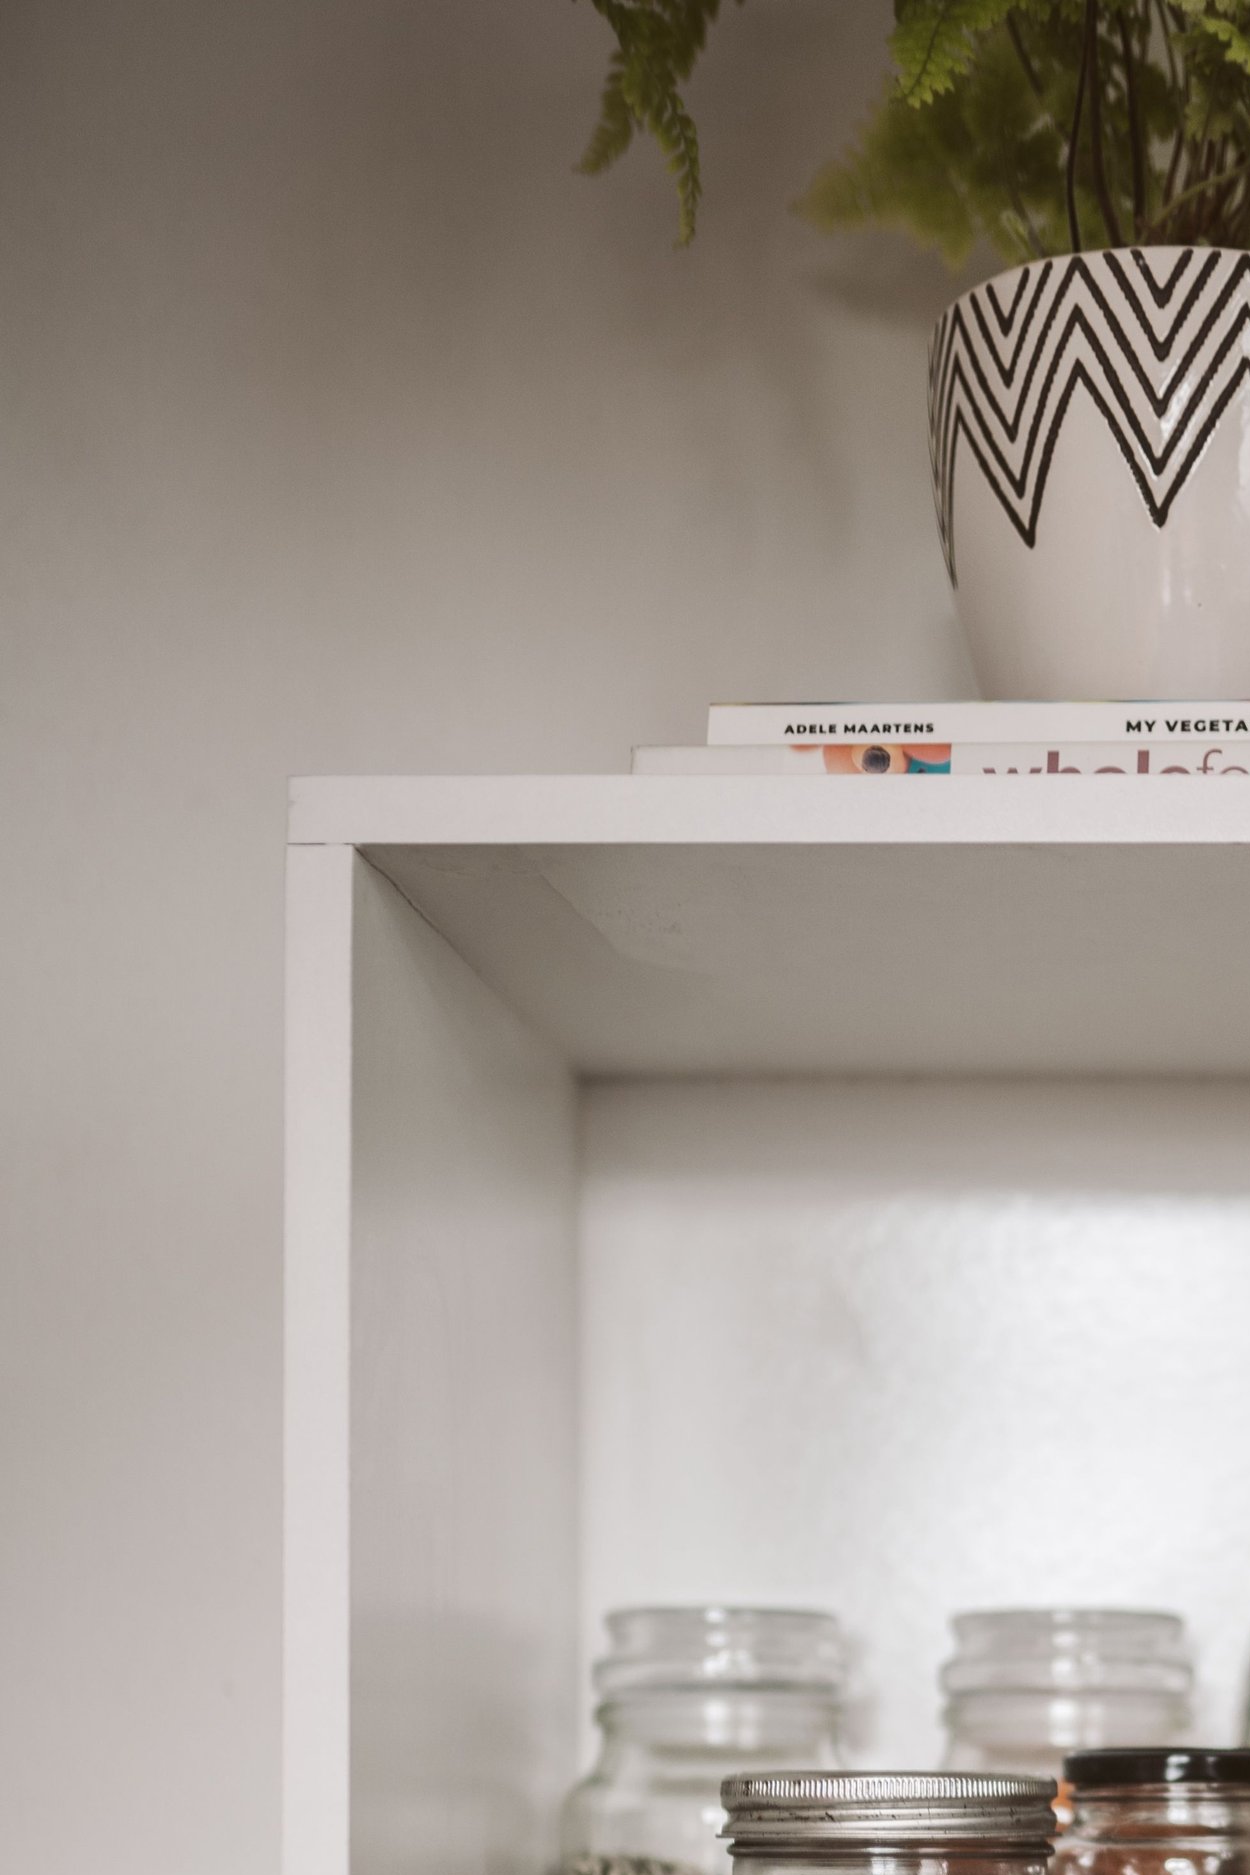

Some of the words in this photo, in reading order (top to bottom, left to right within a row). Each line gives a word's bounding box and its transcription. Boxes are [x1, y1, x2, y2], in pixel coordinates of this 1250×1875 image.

[784, 723, 837, 735] ADELE
[843, 722, 934, 734] MAARTENS
[1125, 720, 1157, 733] MY
